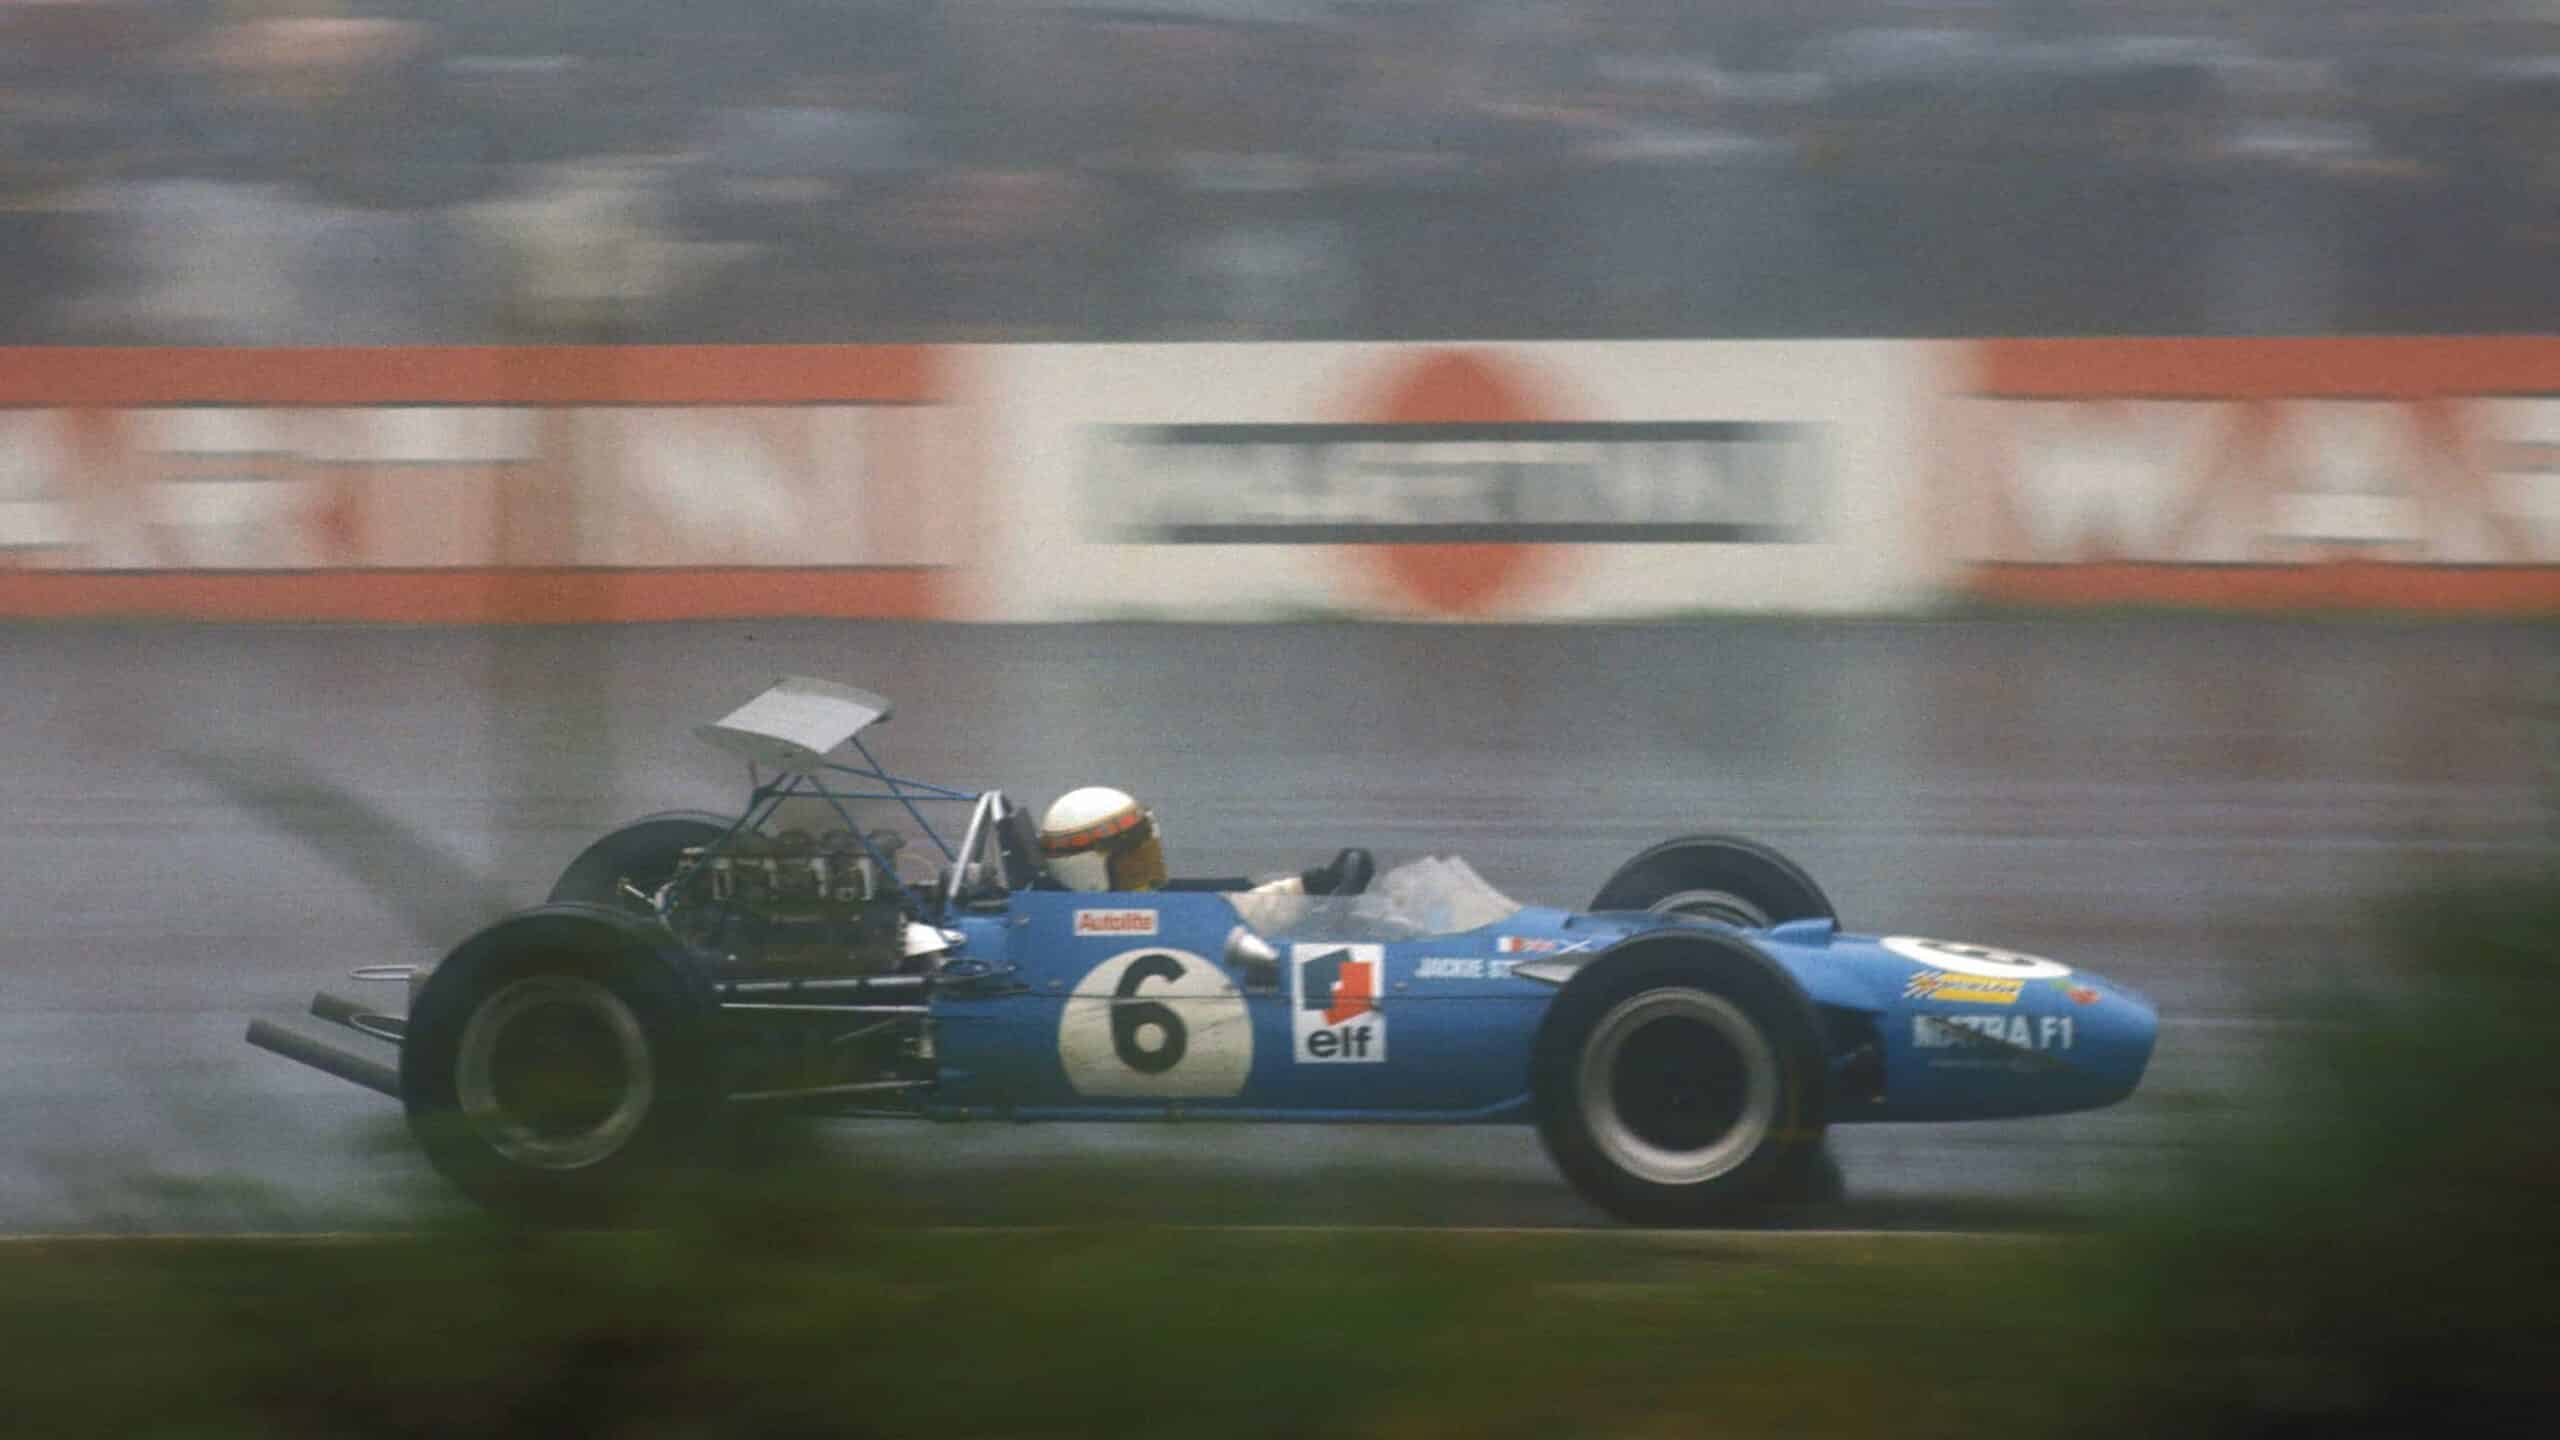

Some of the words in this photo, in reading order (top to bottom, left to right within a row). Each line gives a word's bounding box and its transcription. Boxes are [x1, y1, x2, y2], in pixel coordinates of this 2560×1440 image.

[1078, 912, 1153, 931] Autolite
[1110, 953, 1188, 1074] 6
[1307, 1025, 1372, 1057] elf
[2040, 1016, 2074, 1049] F1
